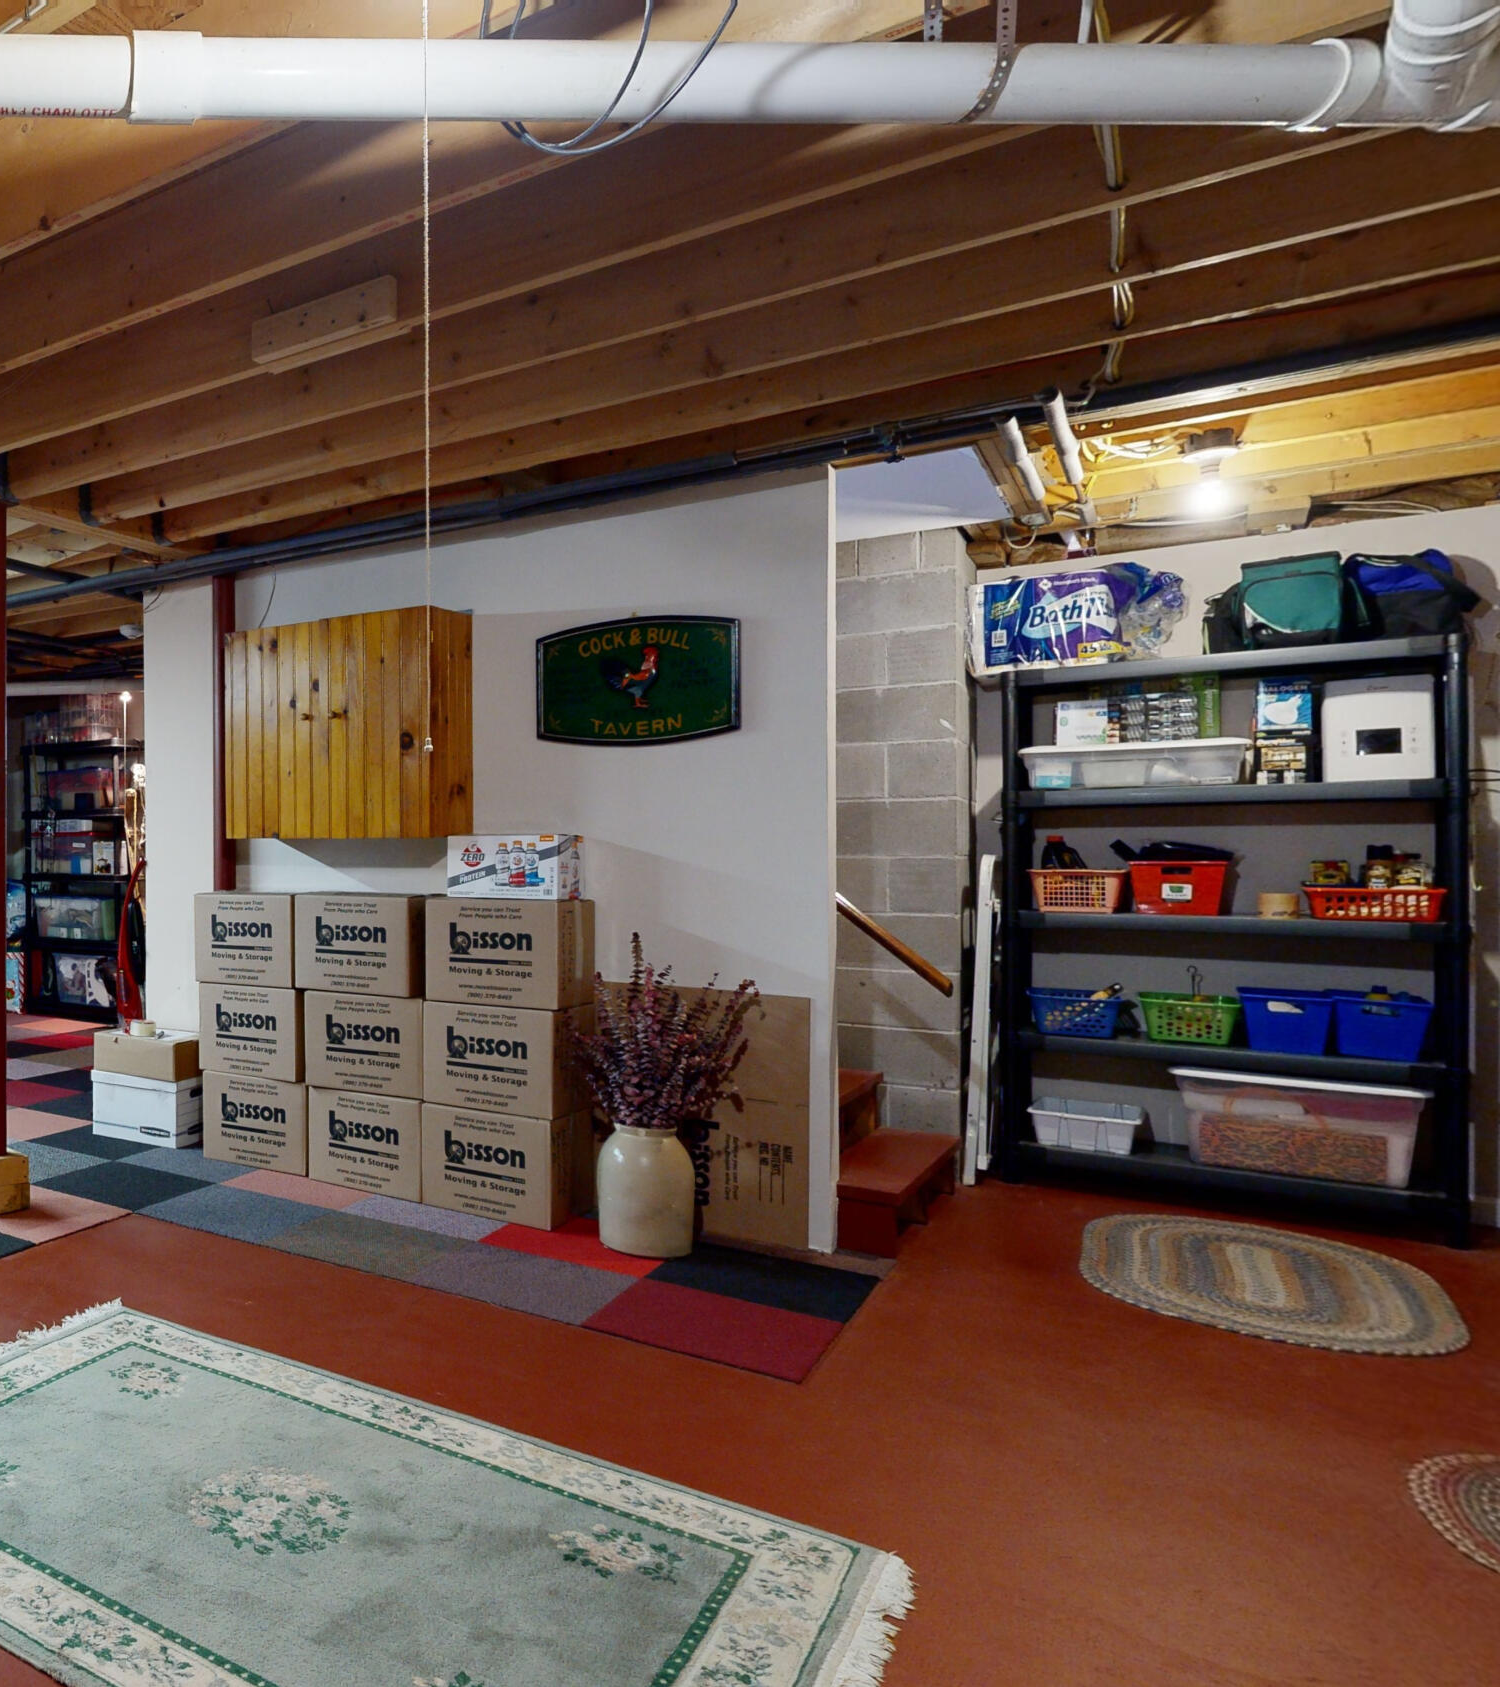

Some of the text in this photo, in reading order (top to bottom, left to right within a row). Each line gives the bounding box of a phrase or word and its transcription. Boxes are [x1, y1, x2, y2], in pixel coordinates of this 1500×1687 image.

[1029, 599, 1083, 628] Bath
[578, 627, 691, 658] COCK & BULL
[588, 712, 683, 736] TAVERN
[460, 853, 486, 862] ZERO
[459, 869, 487, 884] PROTEIN
[211, 914, 272, 942] bisson
[315, 916, 387, 947] bisson
[449, 922, 533, 955] bisson
[211, 952, 236, 960] Moving
[245, 953, 273, 962] Storage
[315, 956, 344, 966] Moving
[354, 959, 387, 969] Storage
[449, 966, 483, 976] Moving
[495, 968, 533, 979] Storage
[216, 1003, 277, 1033] bisson
[326, 1014, 400, 1045] bisson
[216, 1041, 241, 1051] Moving
[249, 1045, 277, 1055] Storage
[446, 1025, 528, 1060] bisson
[326, 1054, 356, 1065] Moving
[367, 1059, 400, 1070] Storage
[446, 1069, 479, 1082] Moving
[491, 1075, 528, 1087] Storage
[221, 1093, 286, 1124] bisson
[221, 1130, 248, 1142] Moving
[257, 1136, 286, 1148] Storage
[328, 1110, 399, 1146] bisson
[328, 1150, 357, 1163] Moving
[359, 1156, 365, 1164] &
[367, 1158, 399, 1171] Storage
[444, 1130, 526, 1169] bisson
[444, 1173, 477, 1188] Moving
[480, 1180, 487, 1188] &
[489, 1182, 526, 1196] Storage
